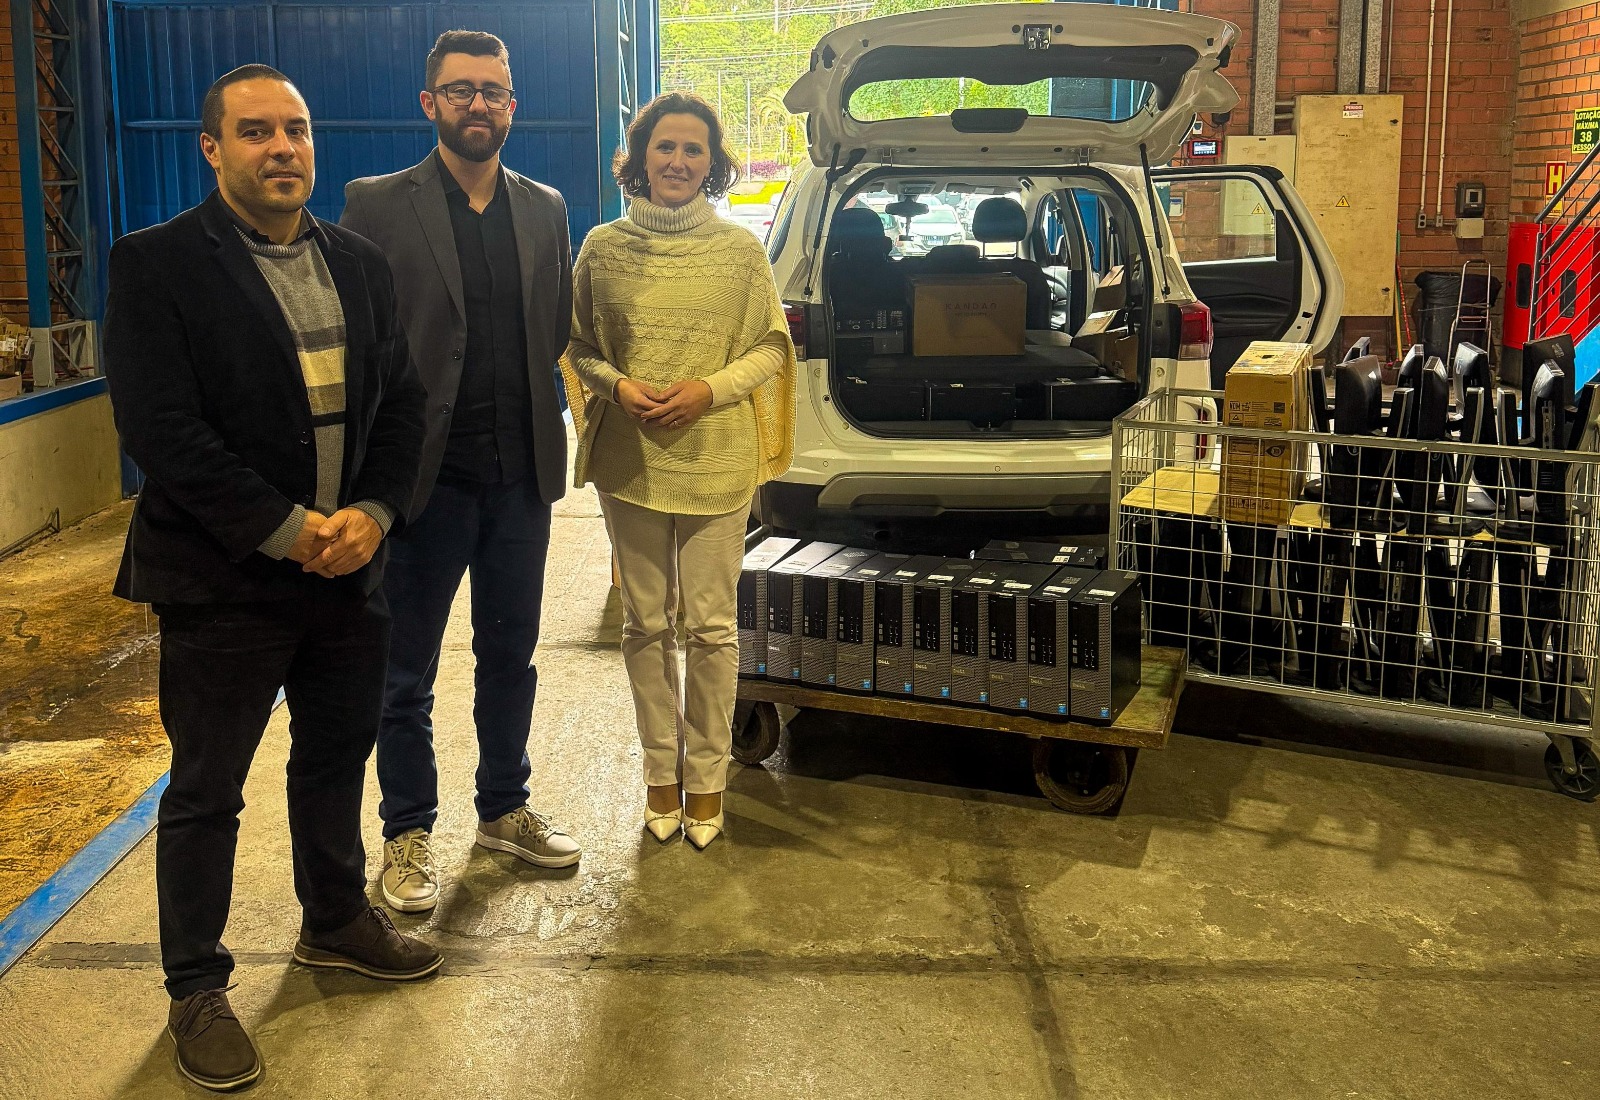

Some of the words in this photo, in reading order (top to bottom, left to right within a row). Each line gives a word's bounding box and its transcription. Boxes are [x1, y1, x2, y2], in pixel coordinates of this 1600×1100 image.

[1576, 120, 1599, 130] MÁXIMA
[1580, 131, 1592, 143] 38
[1549, 165, 1563, 194] H
